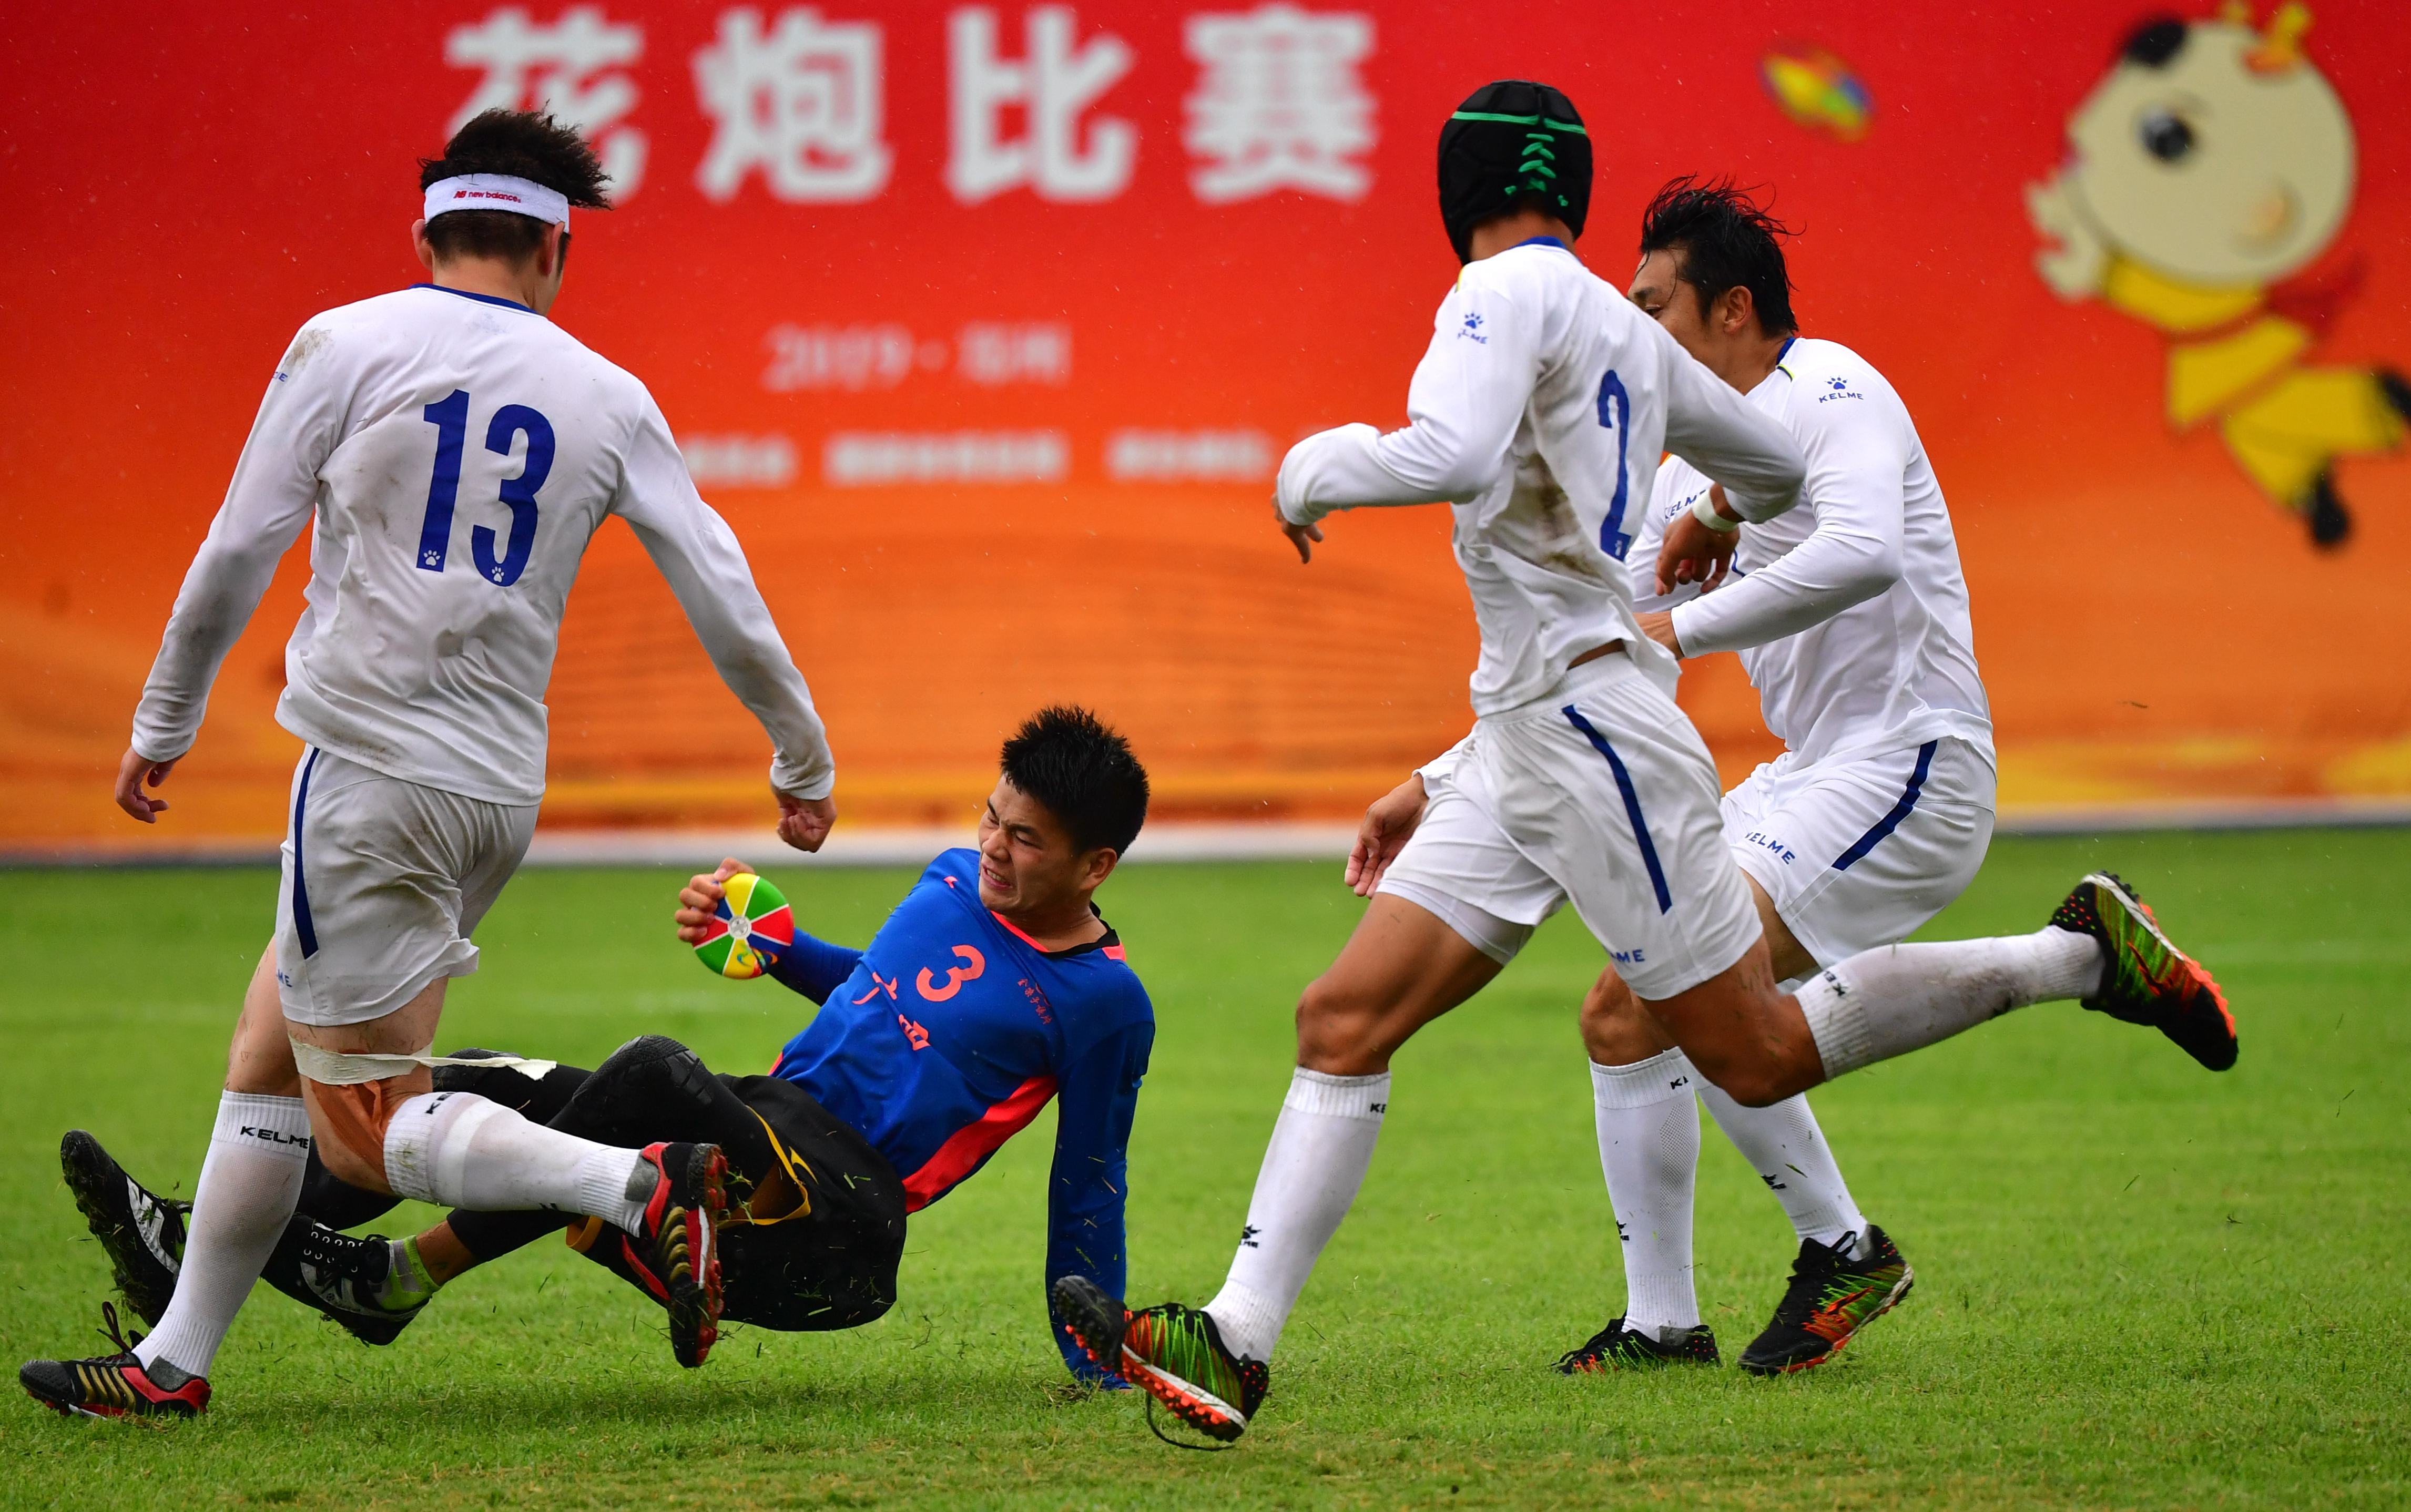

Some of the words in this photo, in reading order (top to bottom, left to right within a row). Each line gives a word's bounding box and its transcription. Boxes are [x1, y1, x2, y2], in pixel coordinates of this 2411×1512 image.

[485, 191, 517, 202] balance
[1818, 392, 1864, 403] KELME
[1596, 369, 1631, 562] 2
[416, 389, 556, 587] 13
[916, 944, 985, 1002] 3
[240, 1126, 309, 1149] KELME
